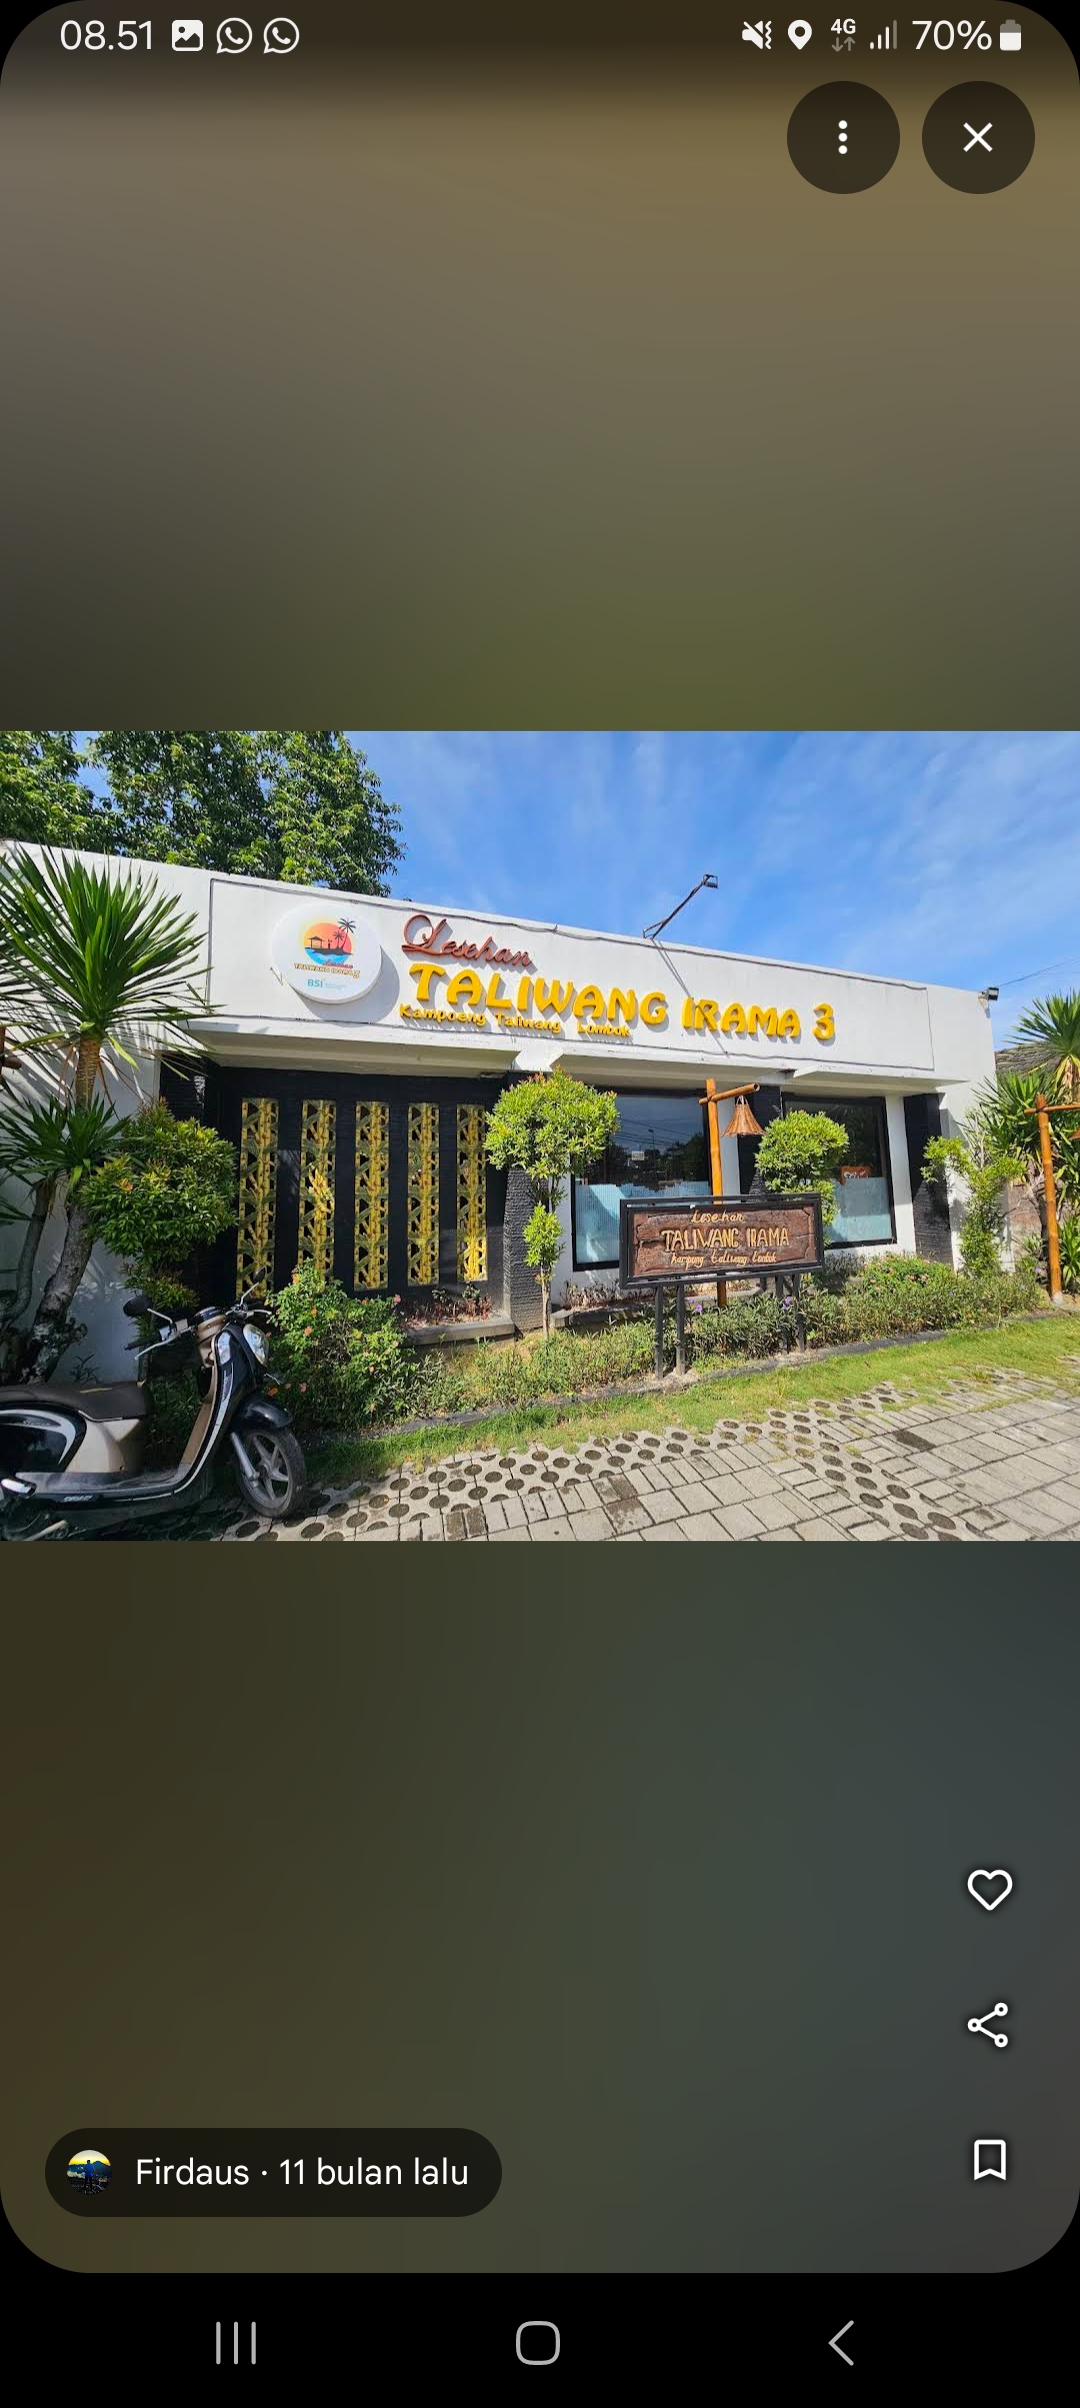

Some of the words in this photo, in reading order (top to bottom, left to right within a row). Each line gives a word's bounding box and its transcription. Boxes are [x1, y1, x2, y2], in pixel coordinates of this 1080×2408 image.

[401, 914, 533, 967] Lesehan
[399, 1003, 487, 1027] Kampoeng
[495, 1011, 561, 1034] Taliwang
[409, 962, 668, 1025] TALIWANG
[681, 995, 801, 1038] IRAMA
[812, 1002, 836, 1041] 3
[660, 1227, 740, 1252] TALIWANG
[746, 1226, 790, 1248] IRAMA
